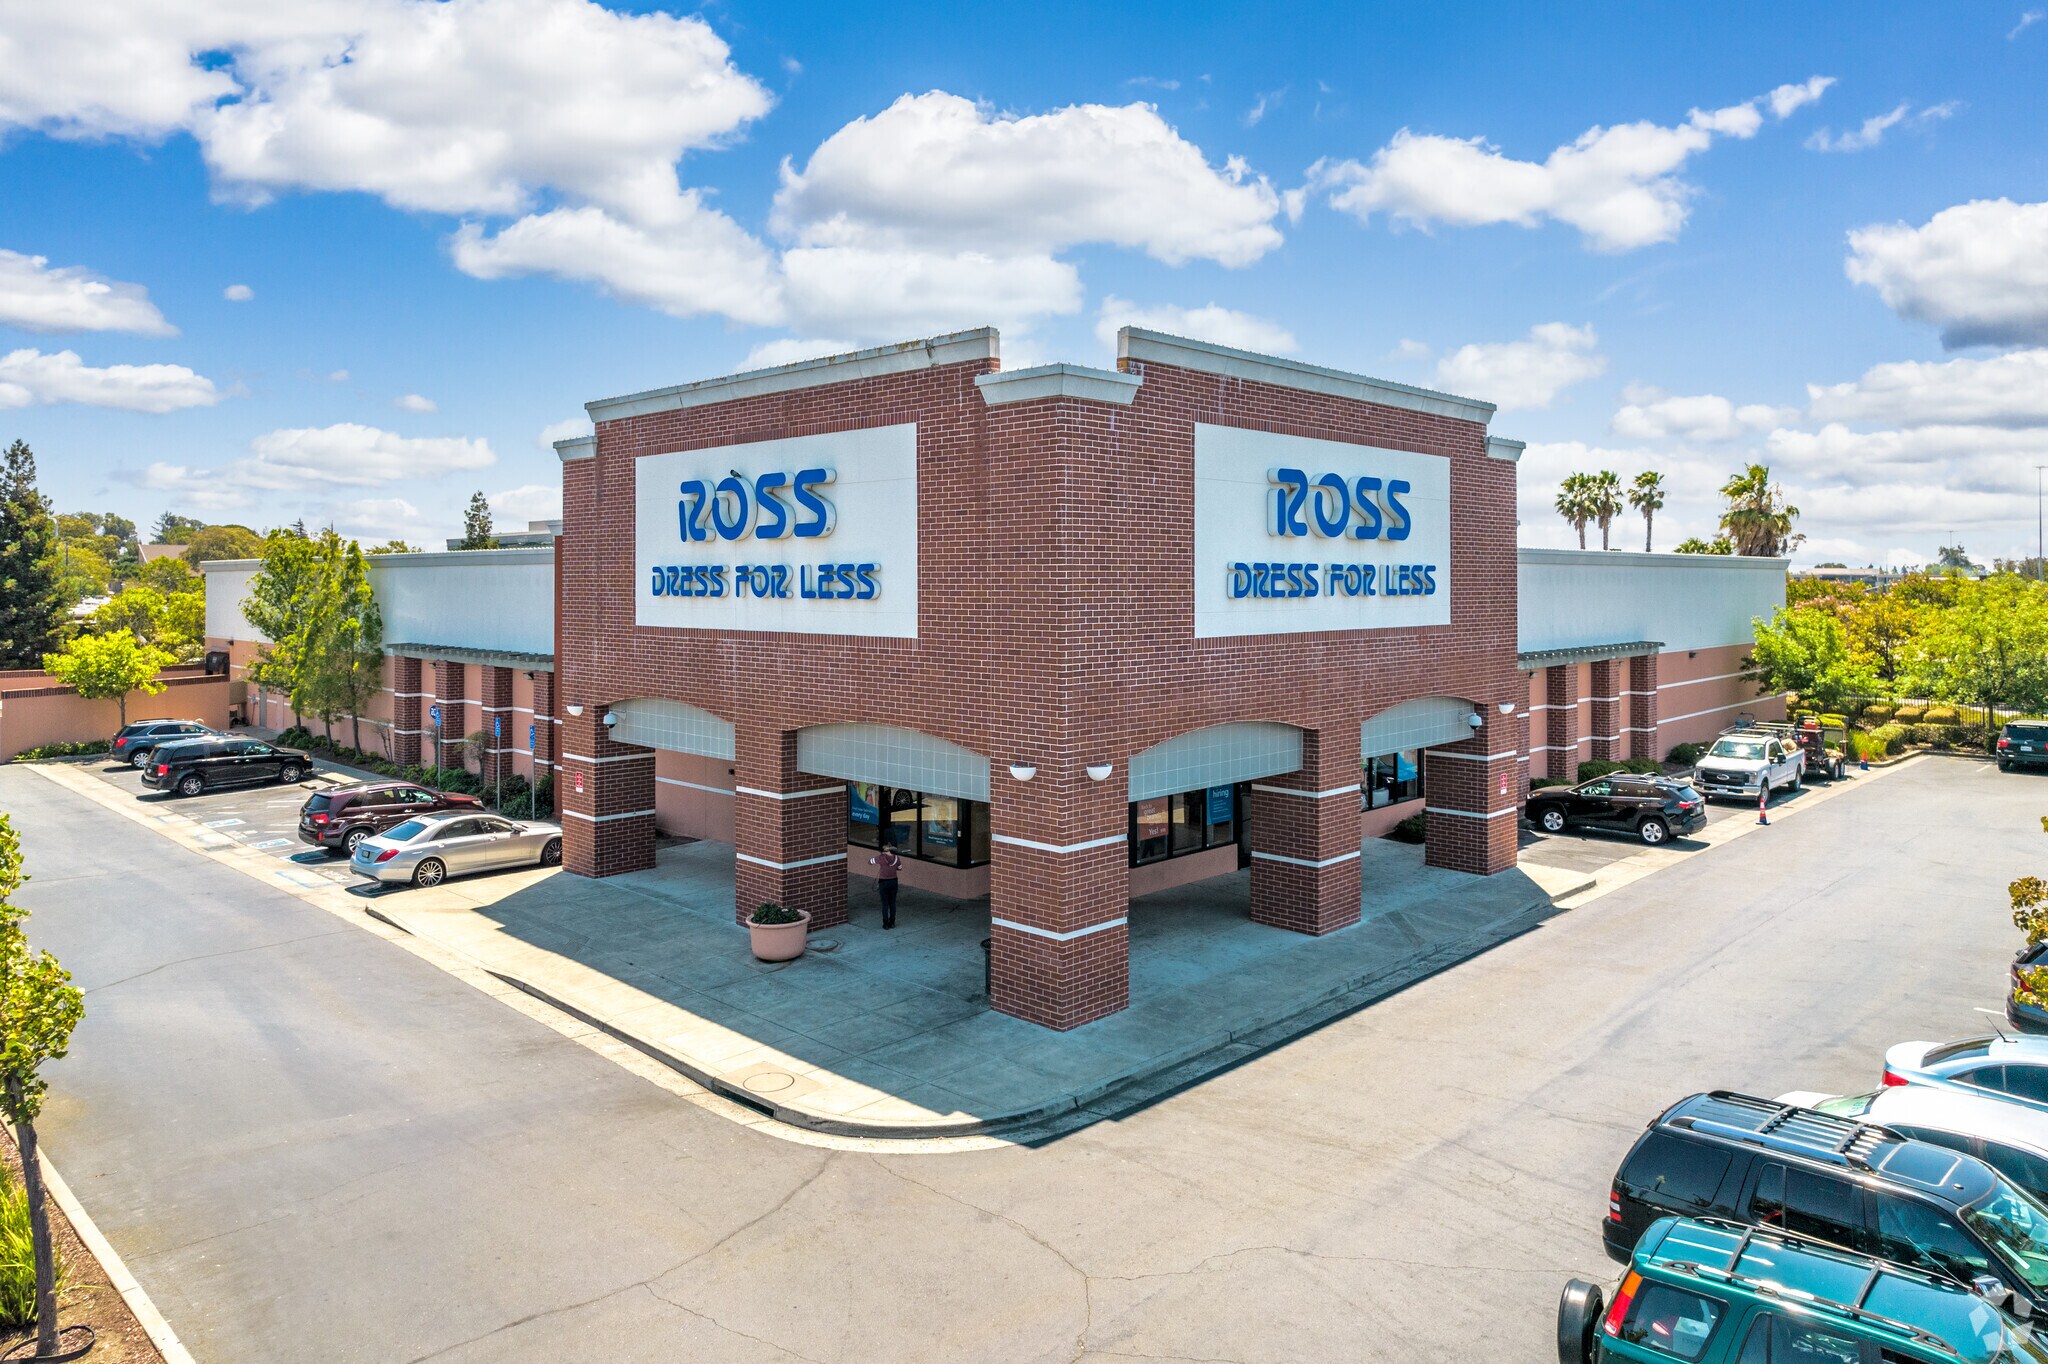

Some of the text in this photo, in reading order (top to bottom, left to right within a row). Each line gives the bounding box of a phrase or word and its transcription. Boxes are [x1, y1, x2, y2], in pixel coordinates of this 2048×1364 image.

[679, 469, 828, 542] ROSS
[1276, 468, 1411, 541] ROSS
[652, 563, 876, 600] DRESS FOR LESS
[1232, 562, 1436, 599] DRESS FOR LESS
[1212, 789, 1229, 798] hiring
